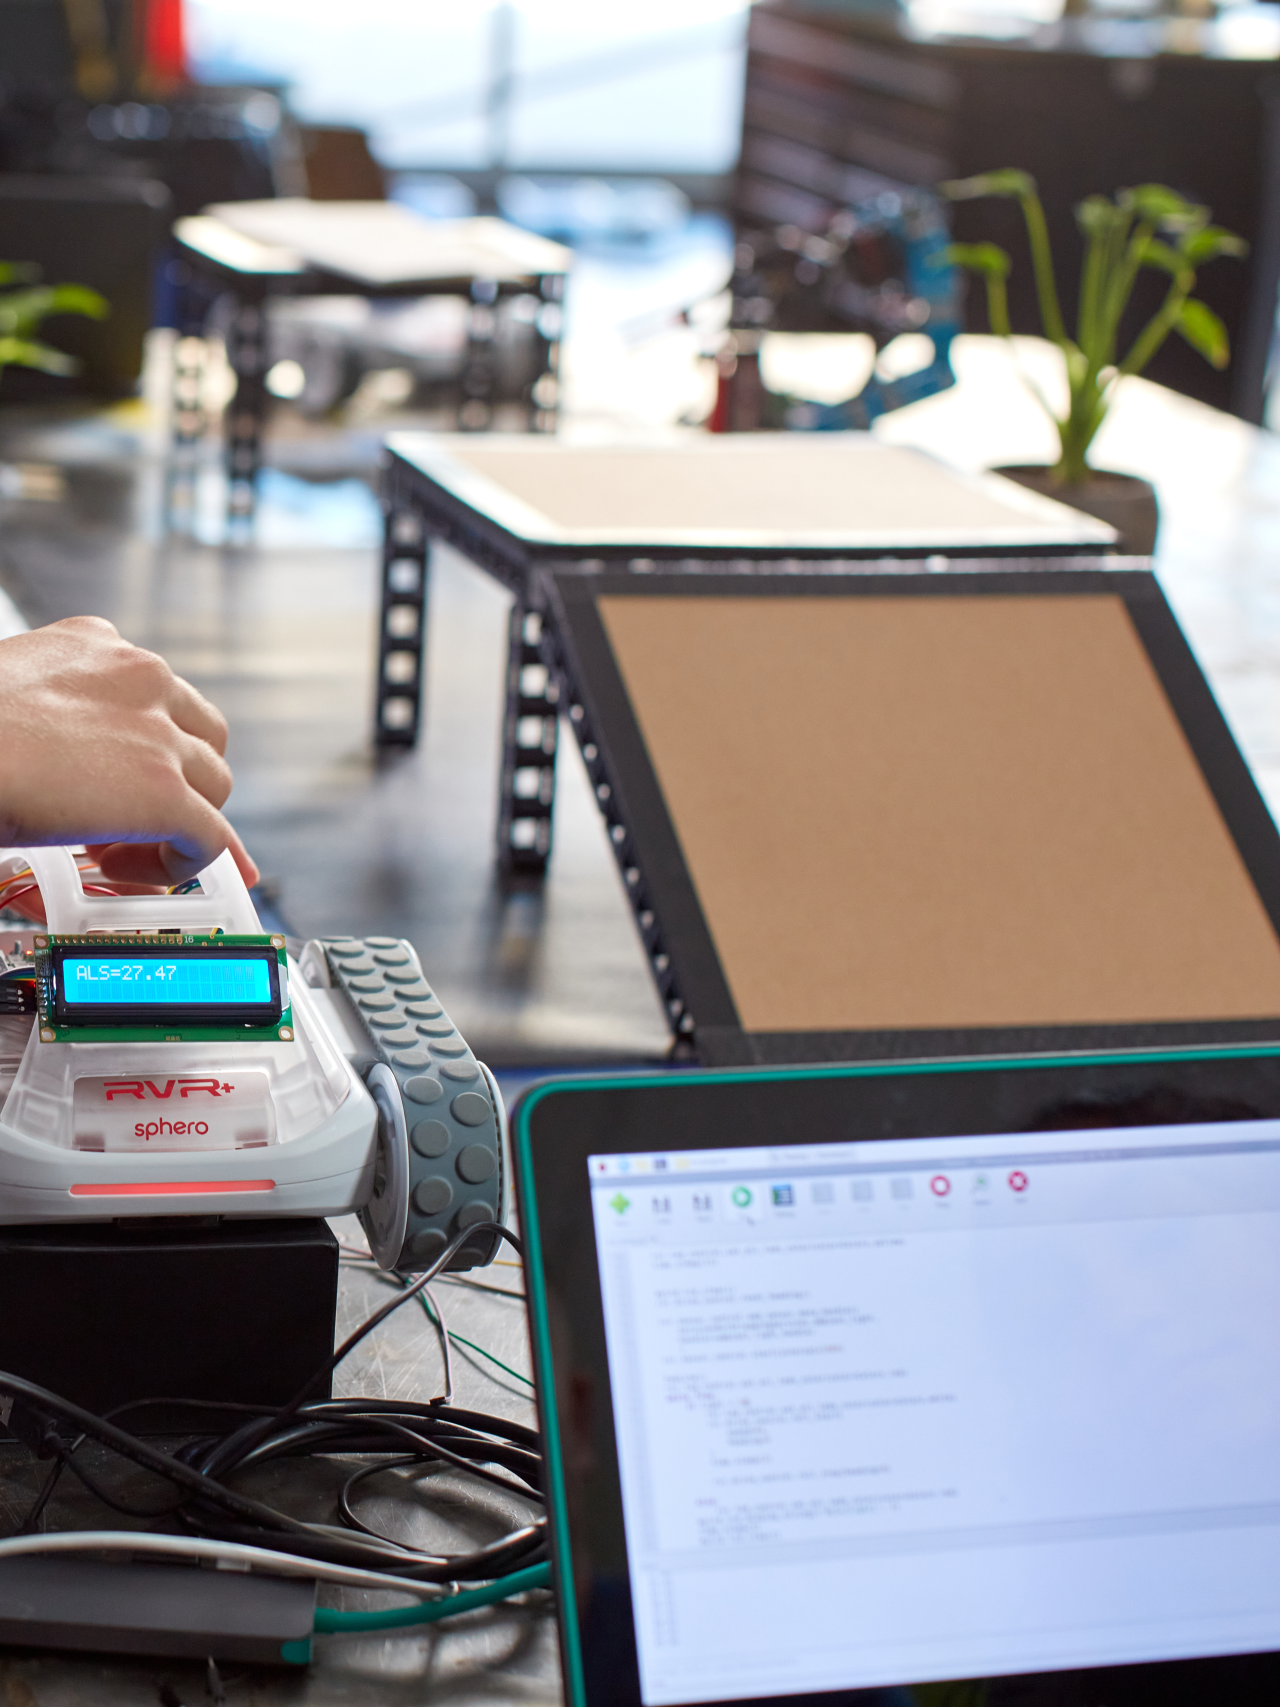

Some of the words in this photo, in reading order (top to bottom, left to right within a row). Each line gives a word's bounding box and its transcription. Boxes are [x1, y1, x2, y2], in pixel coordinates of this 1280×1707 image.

[184, 935, 194, 944] 16
[76, 965, 177, 981] ALS=27.47
[103, 1078, 235, 1101] RVR+
[134, 1117, 209, 1141] sphero
